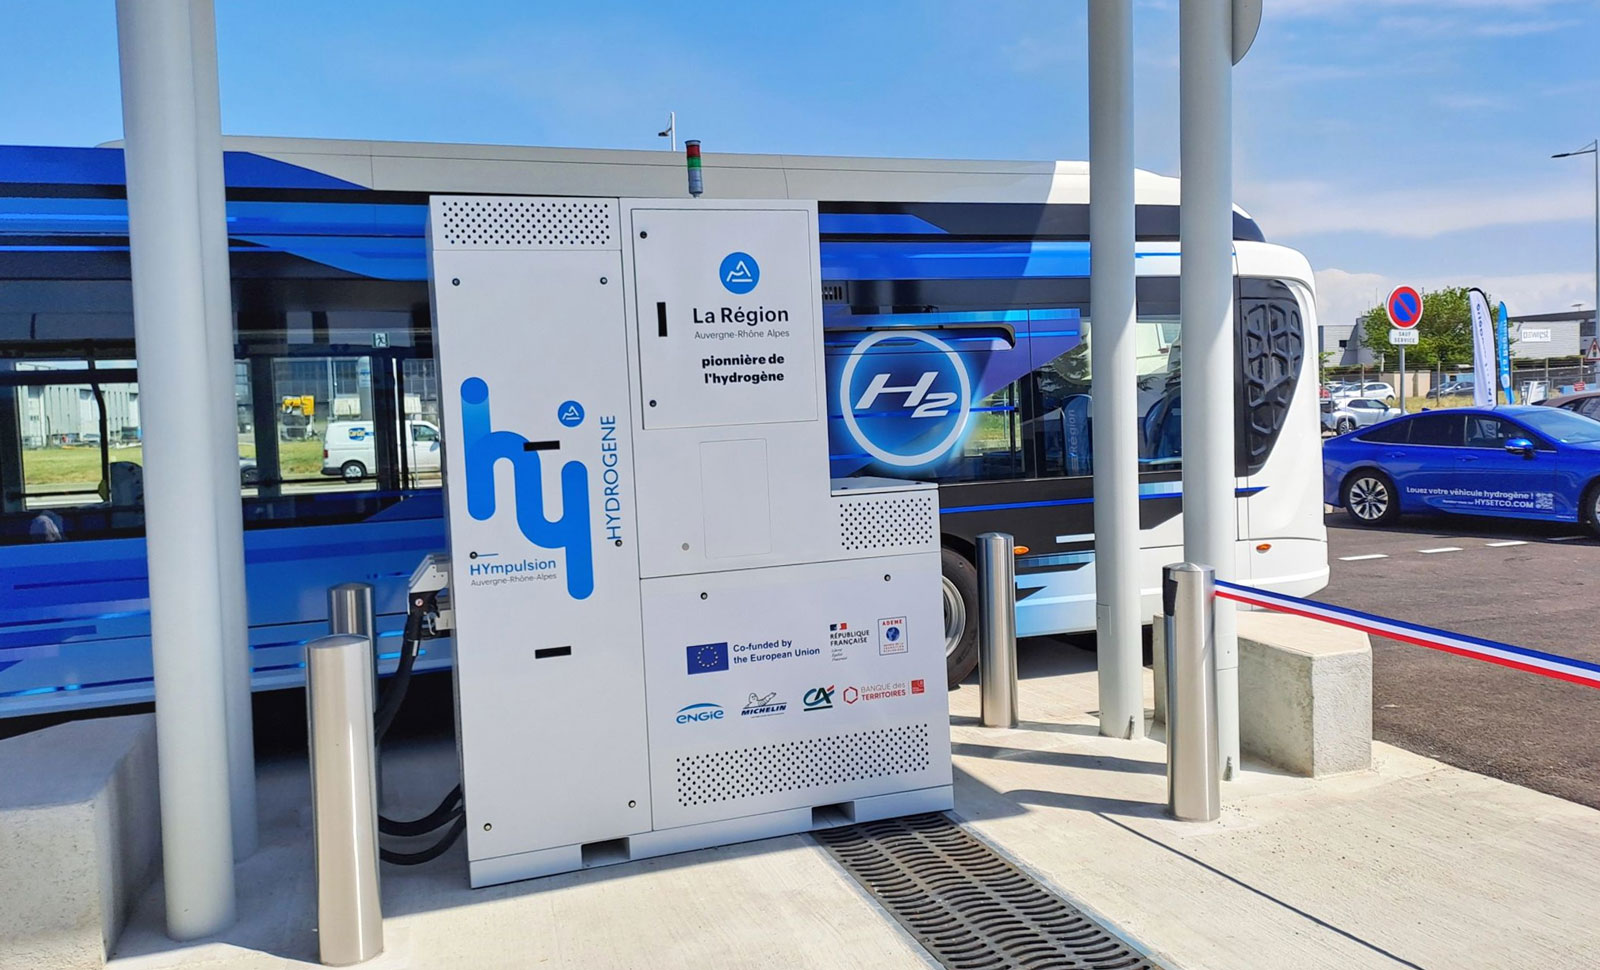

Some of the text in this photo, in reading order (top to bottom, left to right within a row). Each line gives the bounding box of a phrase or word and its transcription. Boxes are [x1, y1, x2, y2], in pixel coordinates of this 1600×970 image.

[693, 306, 789, 326] La Région
[694, 329, 790, 340] Auvergne-Rhône Alpes
[702, 353, 785, 368] pionnière de
[704, 371, 785, 385] l'hydrogène
[854, 372, 958, 418] H2
[600, 416, 622, 540] HYDROGENE
[460, 376, 594, 600] hy
[1406, 486, 1427, 494] Louez
[1450, 488, 1482, 497] véhicule
[1484, 490, 1530, 500] hydrogène
[1474, 498, 1534, 508] HYSETCO.COM
[470, 560, 556, 576] HYmpulsion
[471, 572, 557, 587] Auvergne-Rhône-Alpes
[830, 630, 870, 640] RÉPUBLIQUE
[733, 640, 792, 652] Co-funded by
[830, 638, 868, 647] FRANÇAISE
[734, 648, 820, 664] the European Union
[861, 682, 890, 693] BANQUE
[862, 690, 906, 700] TERRITOIRES
[741, 705, 786, 716] MICHELIN
